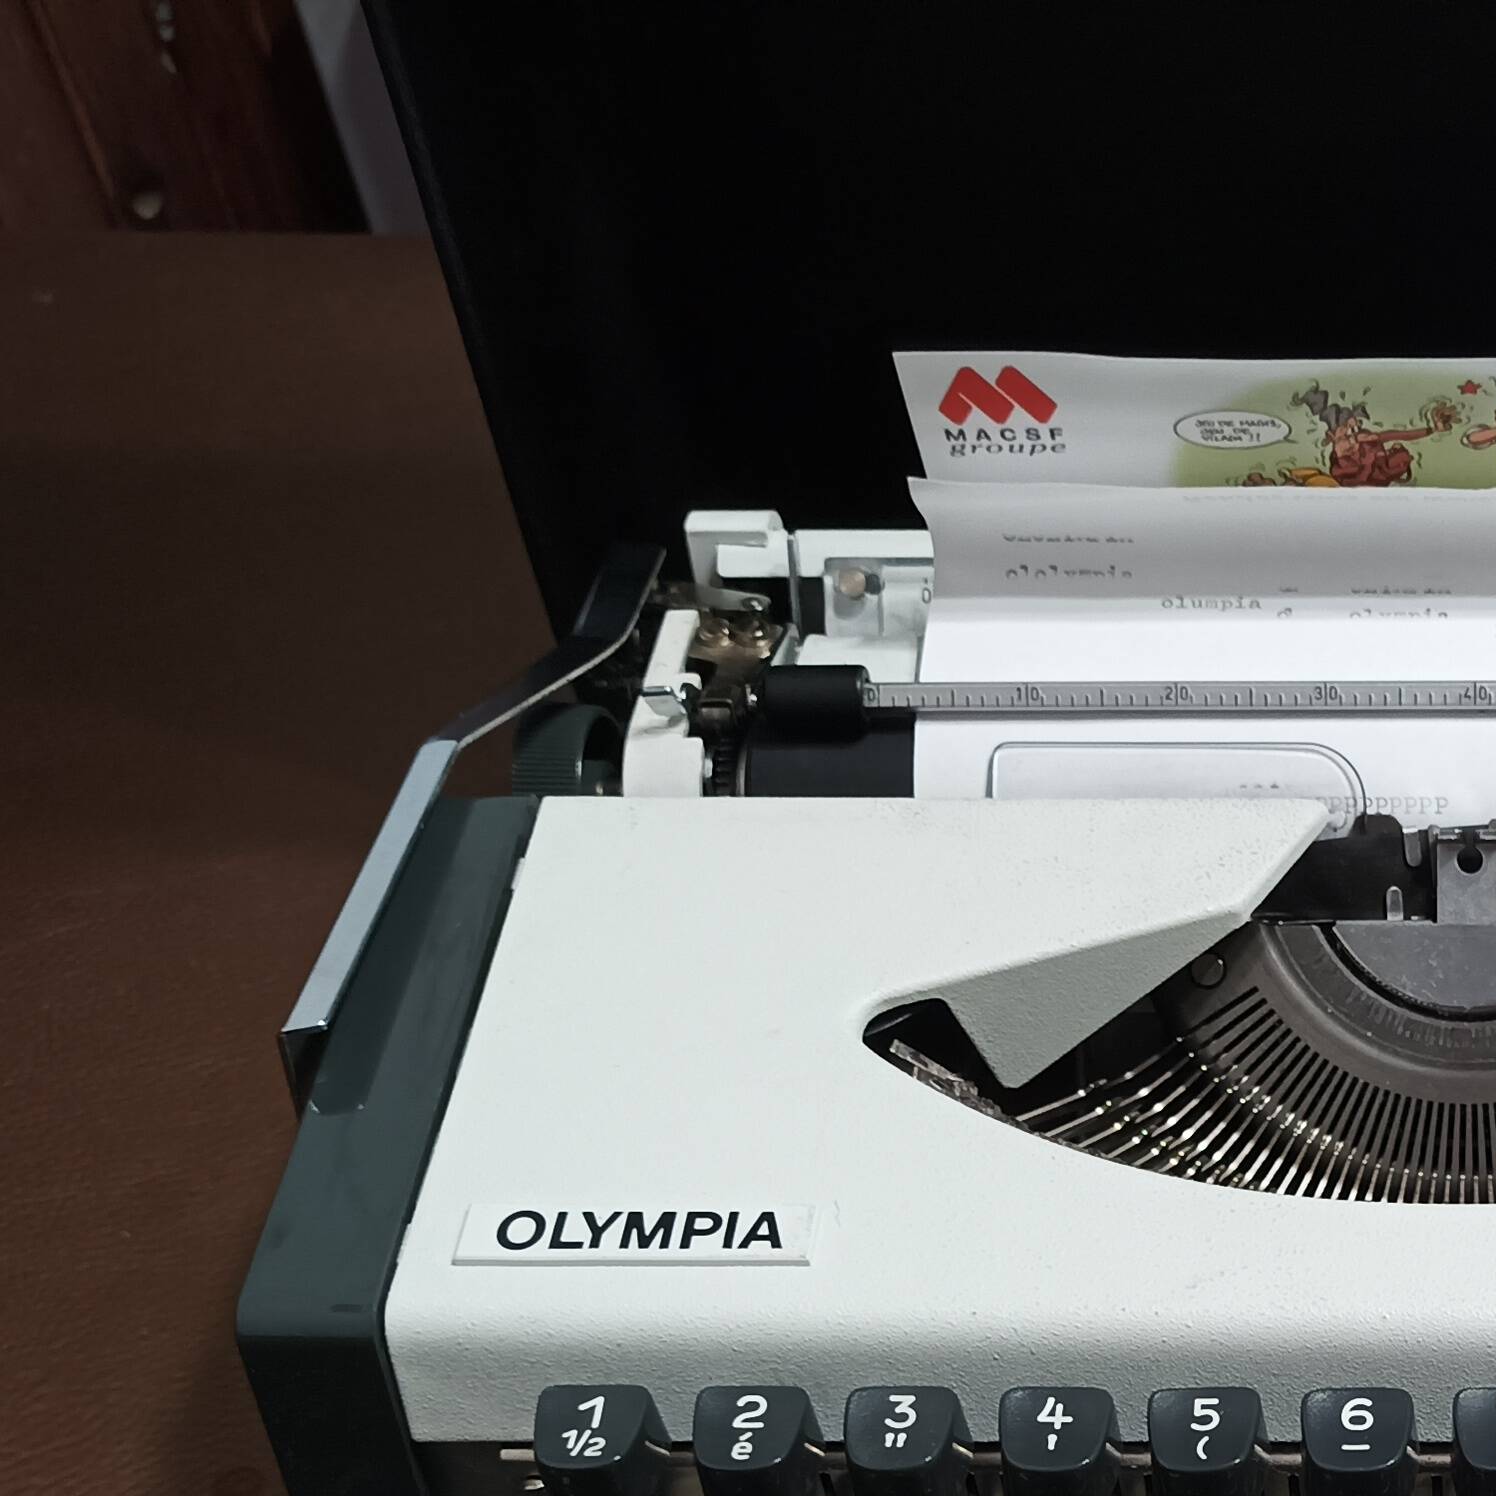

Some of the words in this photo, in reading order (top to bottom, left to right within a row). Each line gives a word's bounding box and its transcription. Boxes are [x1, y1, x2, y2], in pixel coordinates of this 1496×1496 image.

[943, 427, 1064, 442] MACSF
[949, 442, 1067, 457] groupe
[1016, 685, 1040, 701] 10
[1164, 685, 1189, 701] 20
[1313, 685, 1339, 701] 30
[1463, 685, 1488, 701] 40
[496, 1209, 783, 1251] OLYMPIA
[577, 1395, 605, 1429] 1
[732, 1394, 768, 1429] 2
[884, 1394, 917, 1429] 3
[1036, 1396, 1074, 1430] 4
[1190, 1397, 1221, 1432] 5
[1340, 1397, 1374, 1431] 6
[730, 1431, 753, 1461] é
